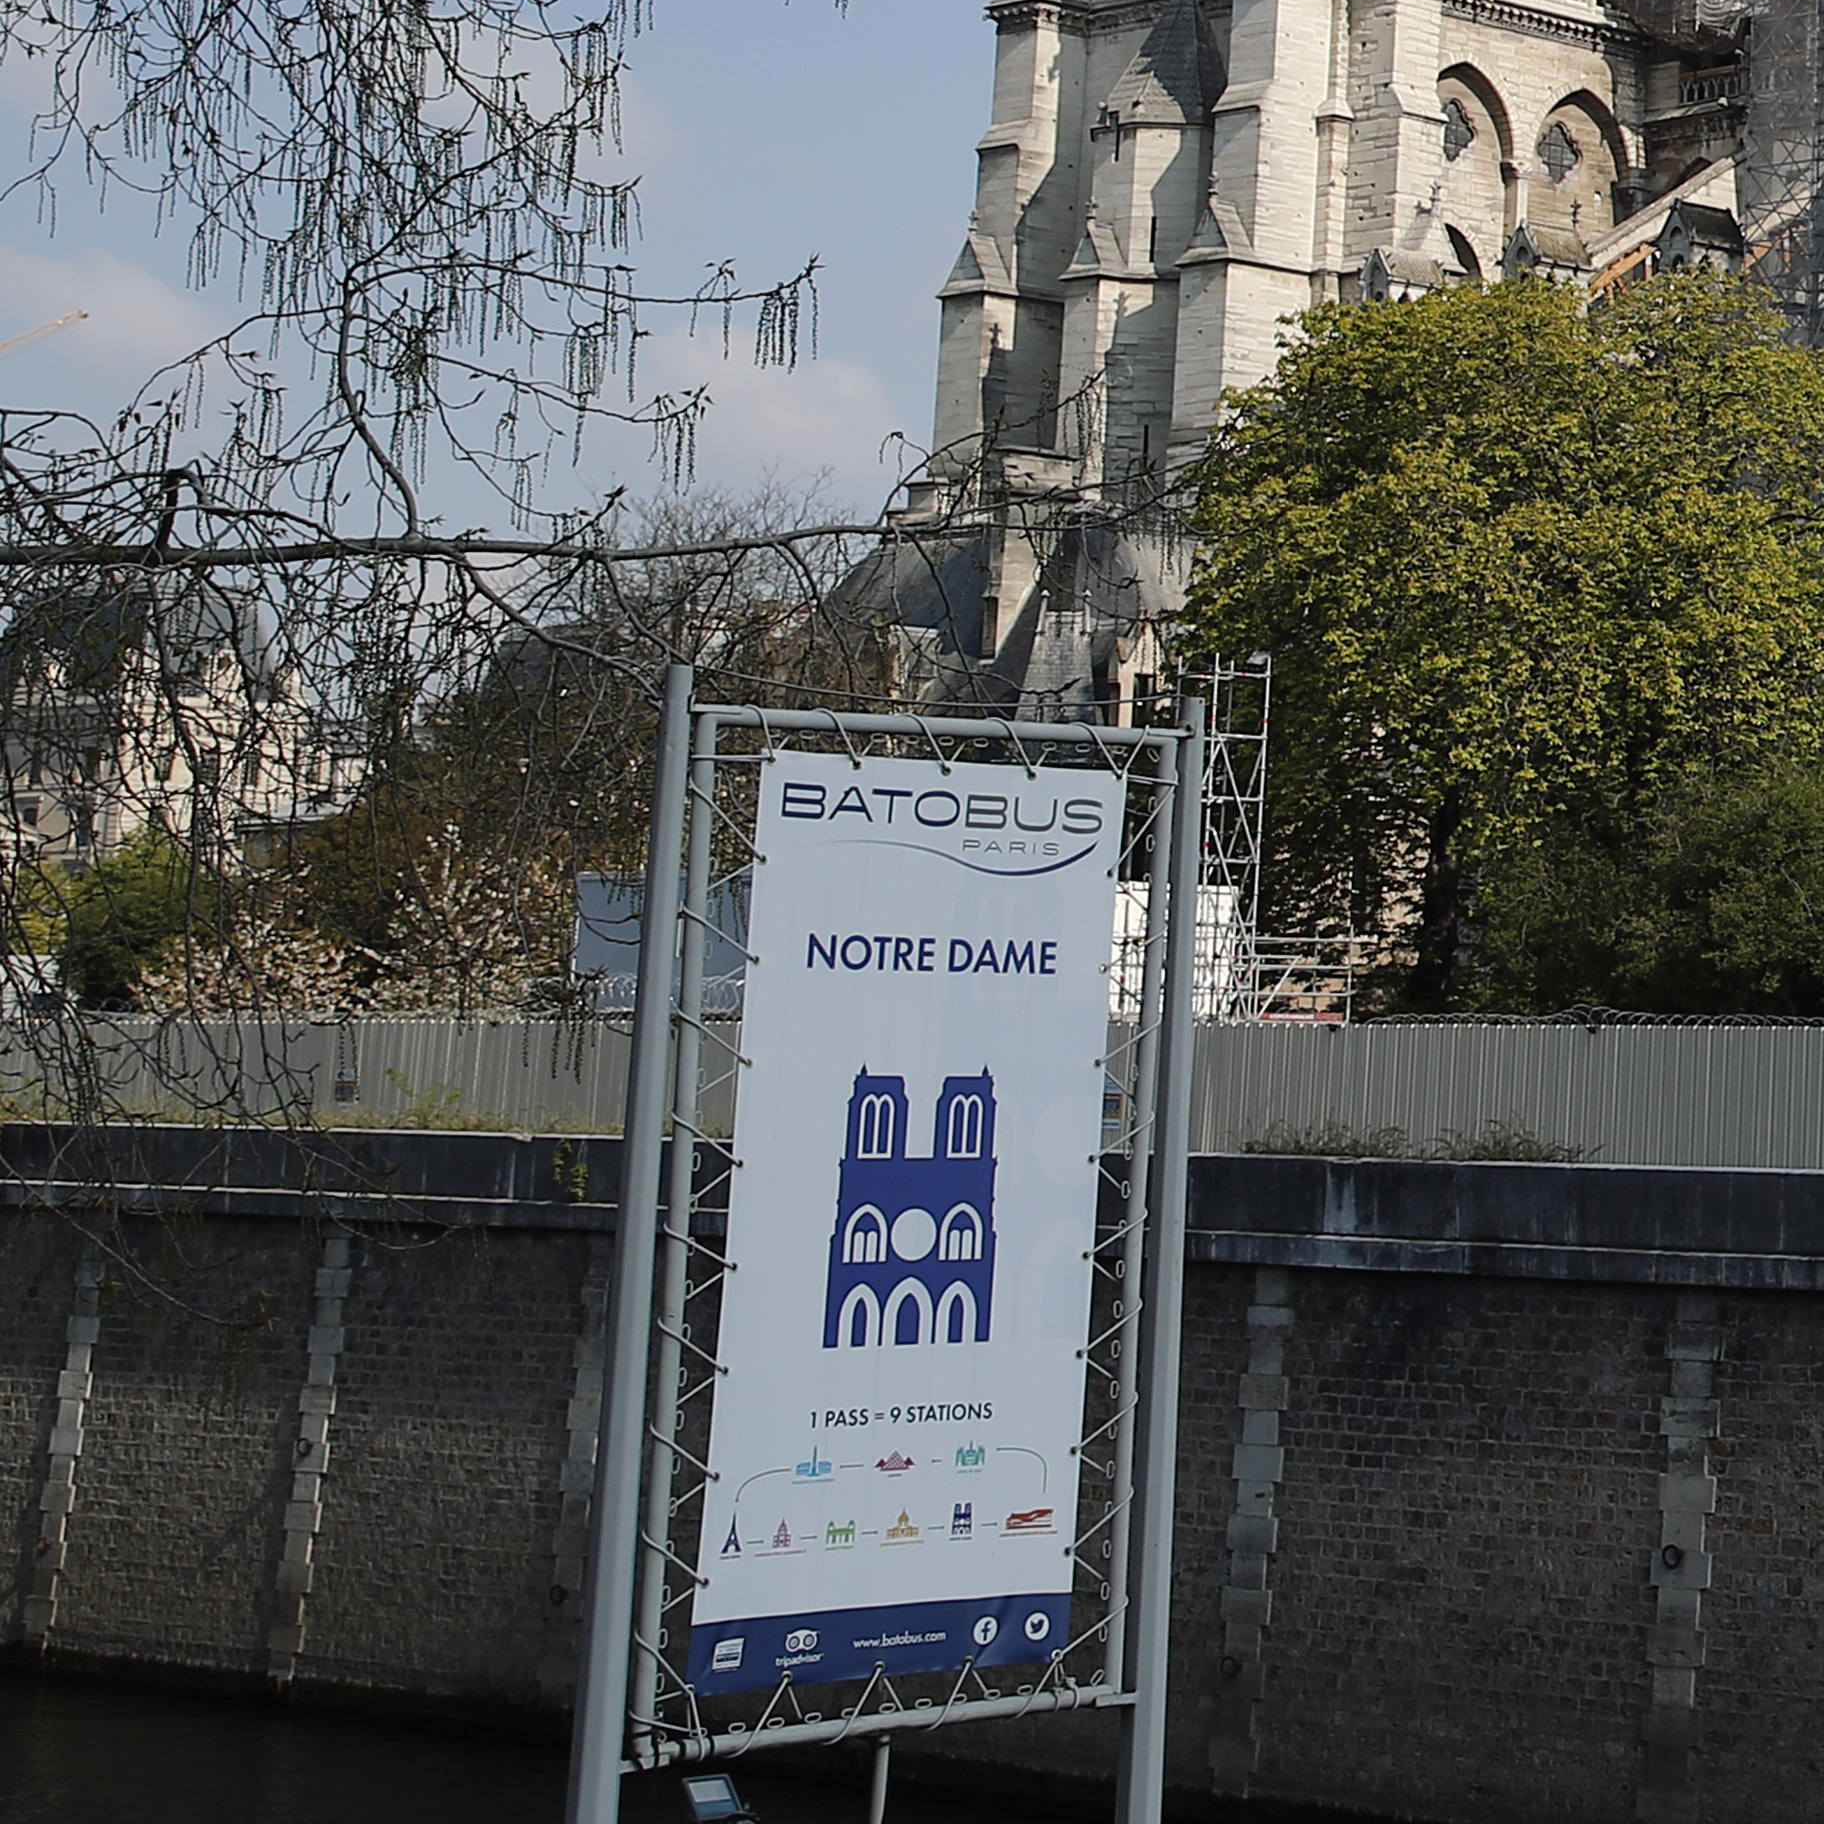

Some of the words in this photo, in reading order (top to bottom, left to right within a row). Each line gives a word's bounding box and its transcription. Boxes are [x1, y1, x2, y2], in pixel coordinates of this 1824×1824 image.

[781, 782, 1103, 834] BATOBUS
[962, 839, 1060, 856] PARIS
[806, 933, 936, 972] NOTRE
[948, 937, 1057, 975] DAME
[810, 1411, 817, 1428] 1
[825, 1408, 869, 1427] PASS
[890, 1406, 902, 1424] 9
[906, 1402, 993, 1423] STATIONS
[853, 1630, 946, 1648] www.batobus.com
